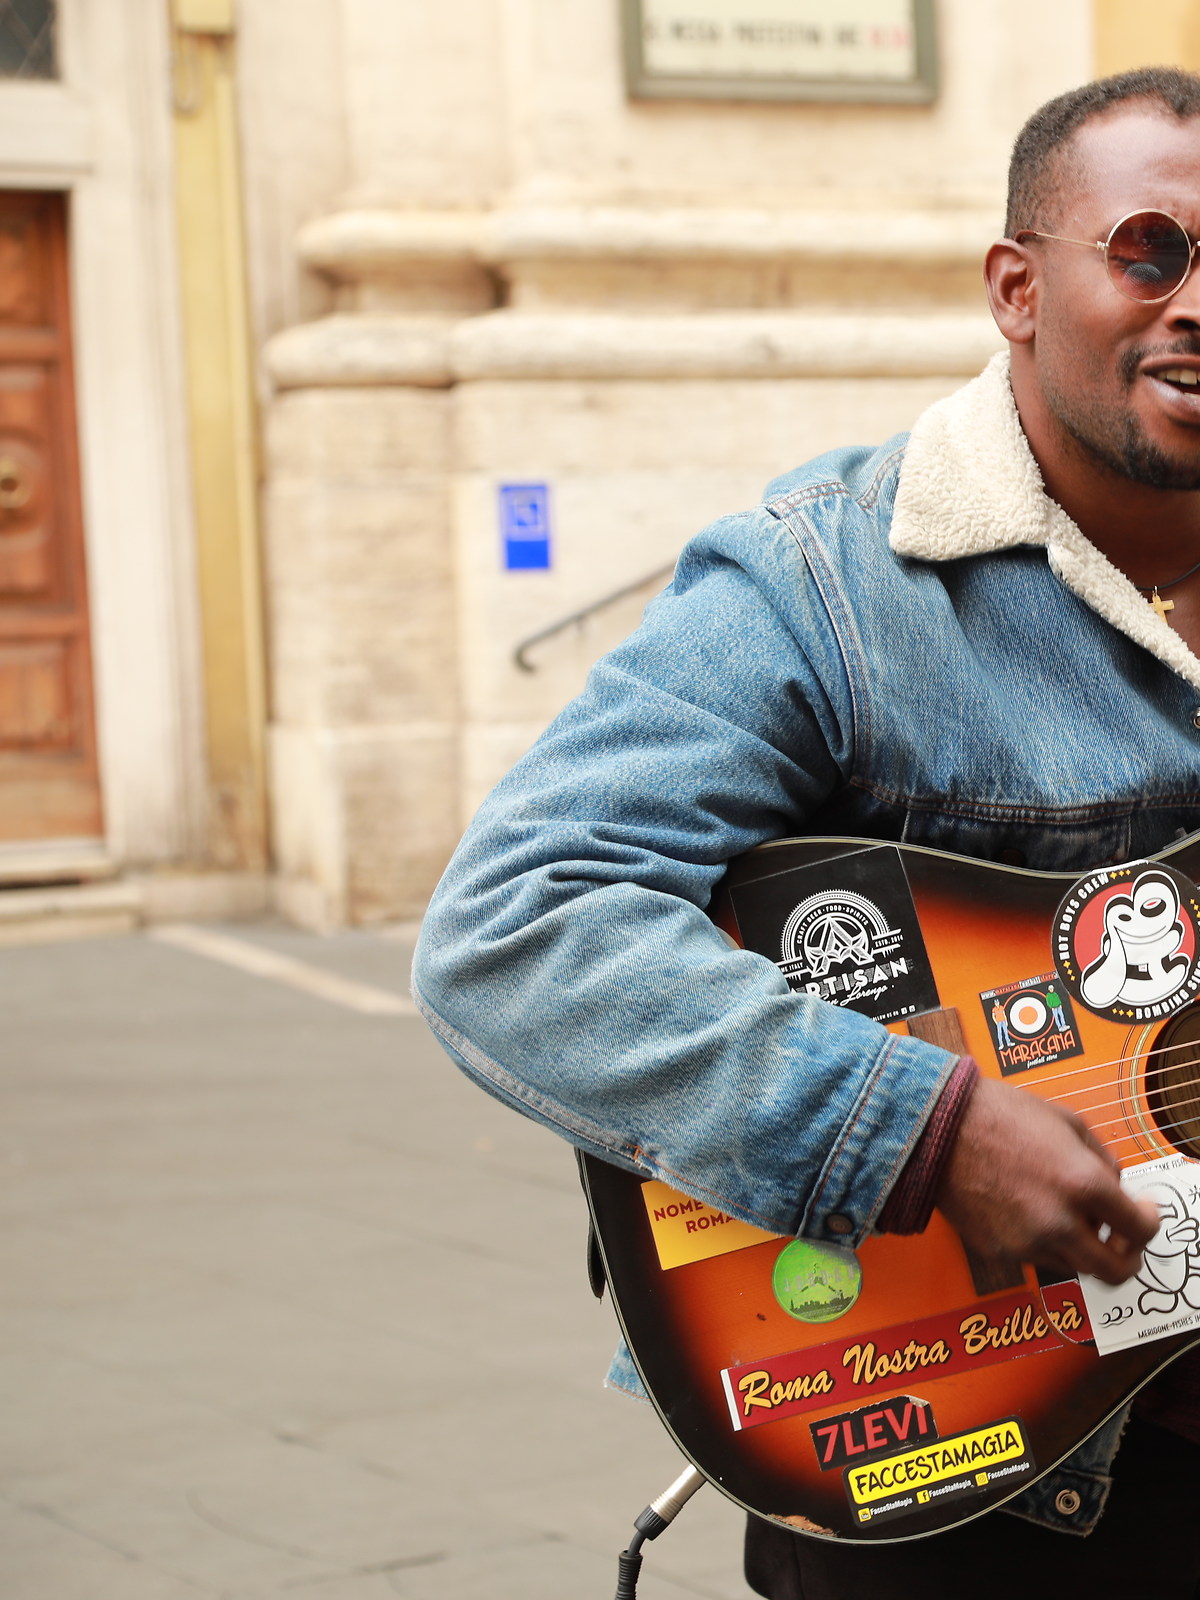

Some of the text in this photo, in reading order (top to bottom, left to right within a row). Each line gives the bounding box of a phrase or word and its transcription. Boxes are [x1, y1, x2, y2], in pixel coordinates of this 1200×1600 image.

[796, 922, 808, 945] CRAFT
[807, 908, 822, 923] BEER
[845, 906, 869, 926] SPIRITS
[1058, 872, 1109, 960] HOT BOYS CREW
[791, 957, 909, 998] RTISAN
[1135, 988, 1190, 1020] BOMBING
[1000, 1030, 1076, 1067] MARACANA
[653, 1200, 704, 1221] NOME
[738, 1300, 1083, 1416] Roma Nostra Brillerà
[817, 1402, 928, 1463] 7LEVI
[855, 1430, 1020, 1496] FACCESTAMAGIA
[987, 1461, 1030, 1480] FacceStaMagia
[870, 1497, 913, 1516] FacceStaMagia
[929, 1479, 972, 1498] FacceStaMagia
